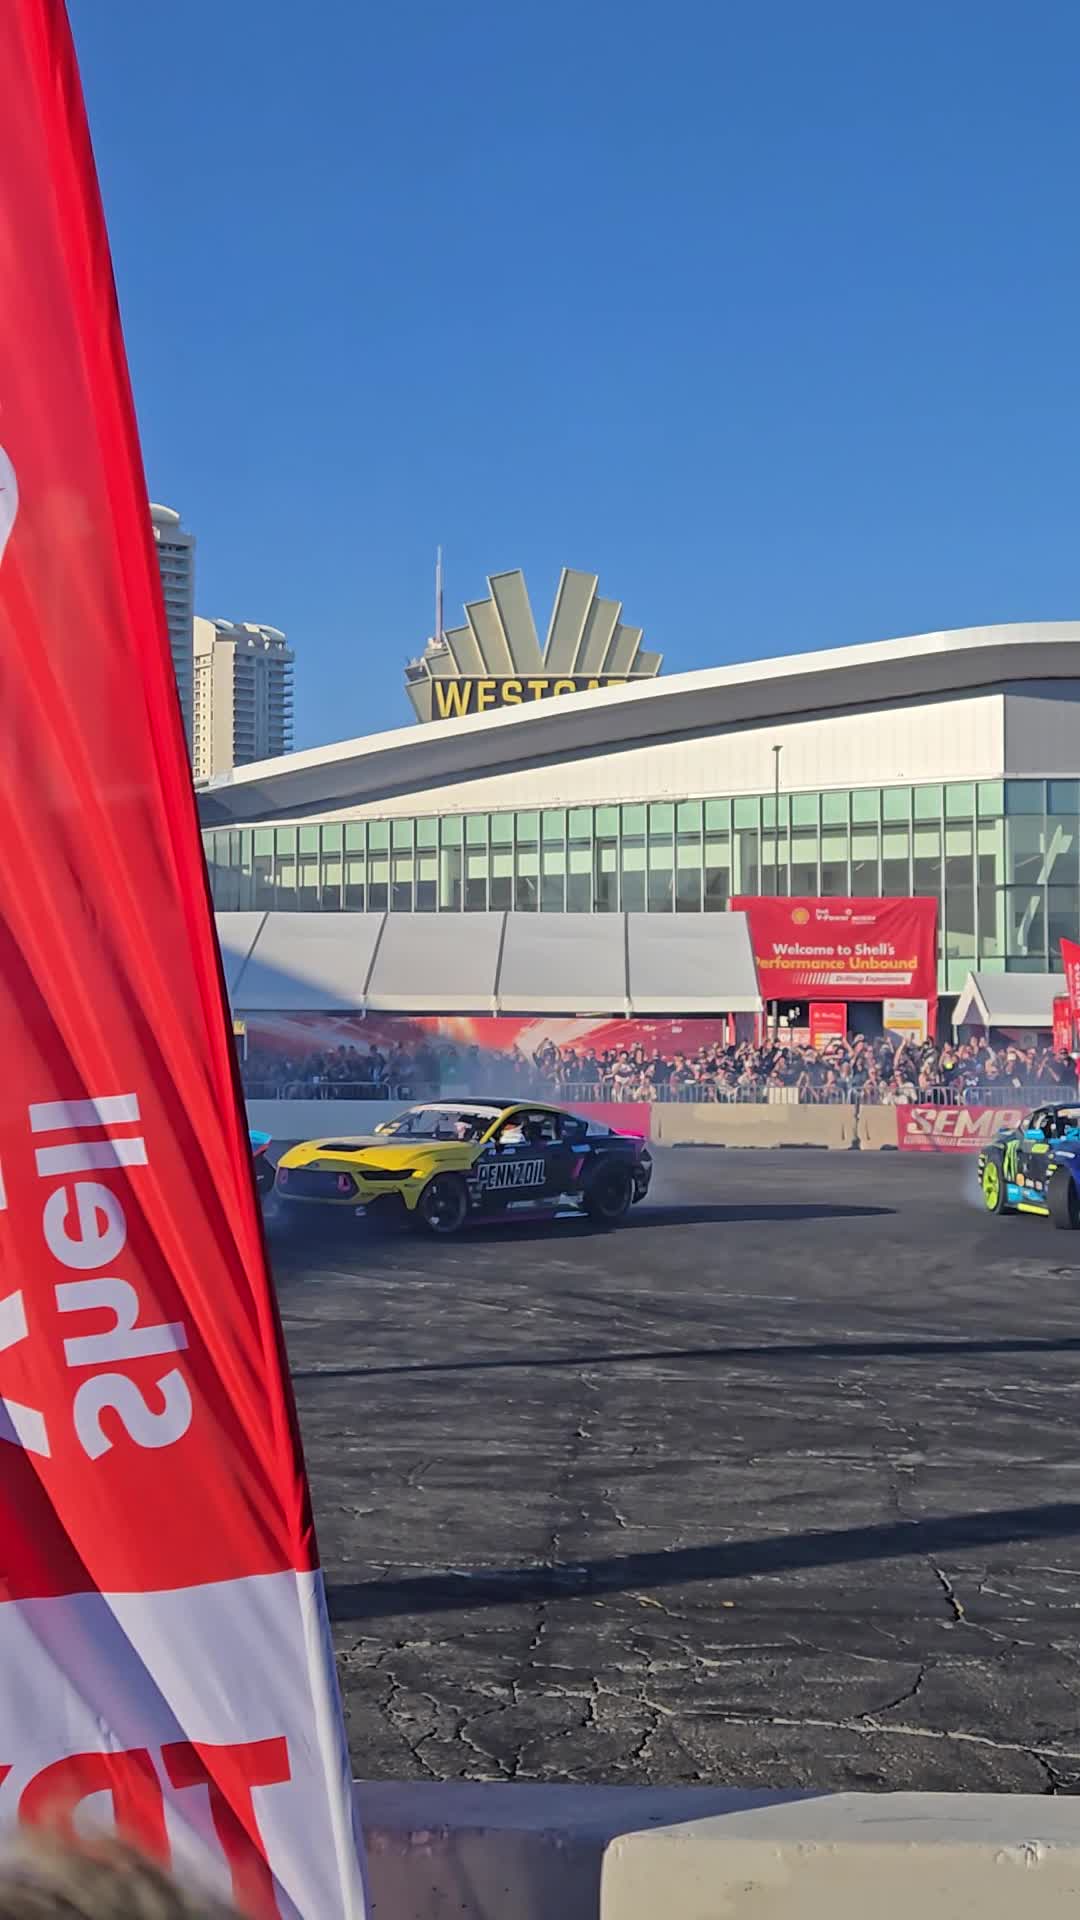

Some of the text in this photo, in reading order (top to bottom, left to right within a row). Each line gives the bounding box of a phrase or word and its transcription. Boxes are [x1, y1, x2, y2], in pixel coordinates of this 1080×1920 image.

[434, 680, 627, 718] WEST
[773, 943, 895, 956] Welcome to Shell's
[849, 956, 918, 969] Unbound
[478, 1160, 546, 1190] PENNZOIL
